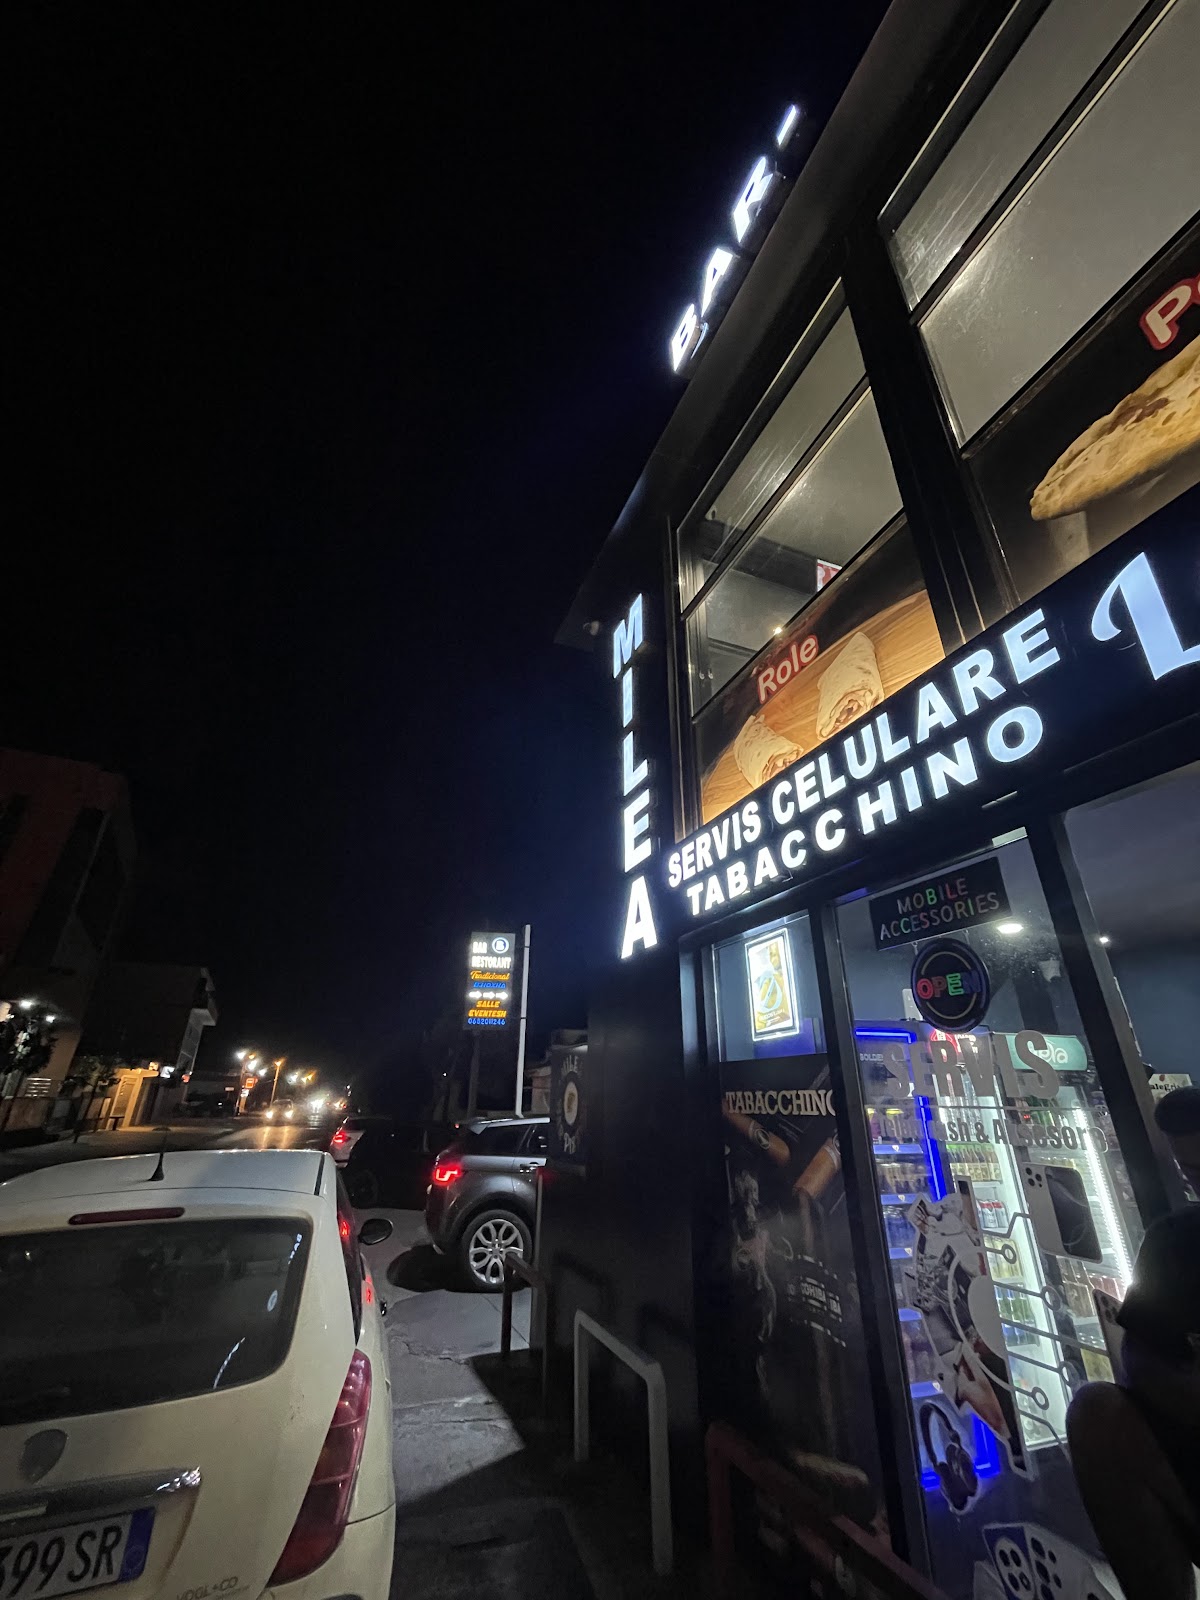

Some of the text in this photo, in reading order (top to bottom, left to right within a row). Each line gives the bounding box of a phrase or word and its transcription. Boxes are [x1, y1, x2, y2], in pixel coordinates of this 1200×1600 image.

[1141, 274, 1200, 347] P
[758, 635, 818, 703] Role
[668, 608, 1061, 888] SERVIS CELULARE
[611, 592, 658, 961] MILEA
[686, 705, 1044, 916] TABACCHINO
[879, 890, 1000, 941] ACCESSORIES
[896, 877, 968, 915] MOBILE
[470, 970, 510, 980] Tradicional
[471, 955, 512, 969] RESTORANT
[916, 972, 982, 1000] OPEN
[468, 1009, 507, 1018] EVENTESH
[476, 1000, 501, 1008] SALLE
[880, 1029, 1061, 1099] SERVIS
